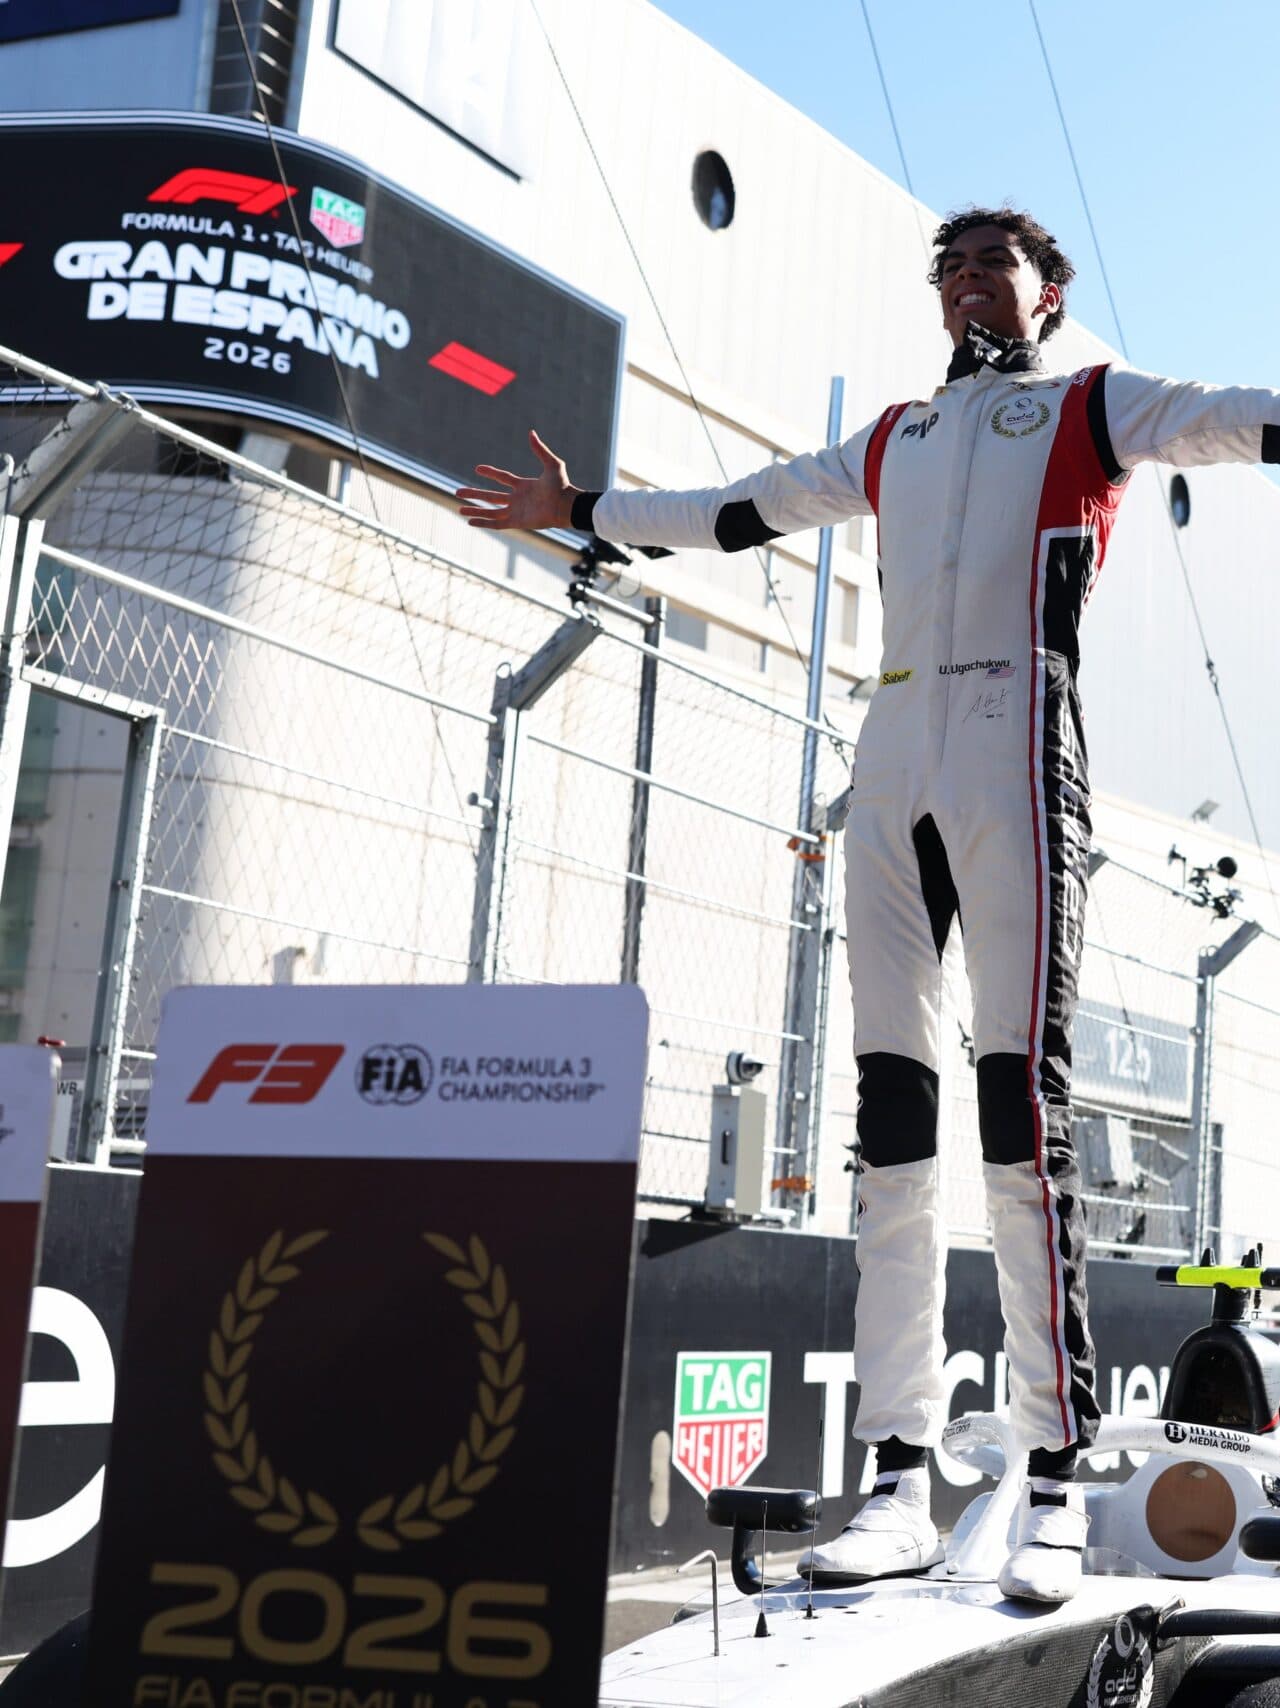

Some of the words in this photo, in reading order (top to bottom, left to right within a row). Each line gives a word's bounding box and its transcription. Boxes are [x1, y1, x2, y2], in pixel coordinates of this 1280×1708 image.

[121, 212, 235, 239] FORMULA
[241, 226, 255, 242] 1
[274, 232, 313, 258] TAG
[316, 246, 374, 284] HEUER
[53, 241, 225, 286] GRAN
[230, 250, 411, 350] PREMIO
[87, 281, 167, 321] DE
[172, 283, 379, 379] ESPAÑA
[203, 337, 292, 374] 2026
[185, 1043, 347, 1105] F3
[438, 1080, 596, 1102] CHAMPIONSHIP
[439, 1057, 469, 1077] FIA
[476, 1057, 575, 1078] FORMULA
[579, 1057, 591, 1078] 3
[684, 1361, 762, 1412] TAG
[678, 1421, 763, 1489] HEUER
[1189, 1425, 1250, 1443] HERALDO
[1189, 1437, 1219, 1448] MEDIA
[1220, 1442, 1250, 1453] GROUP
[139, 1562, 553, 1680] 2026
